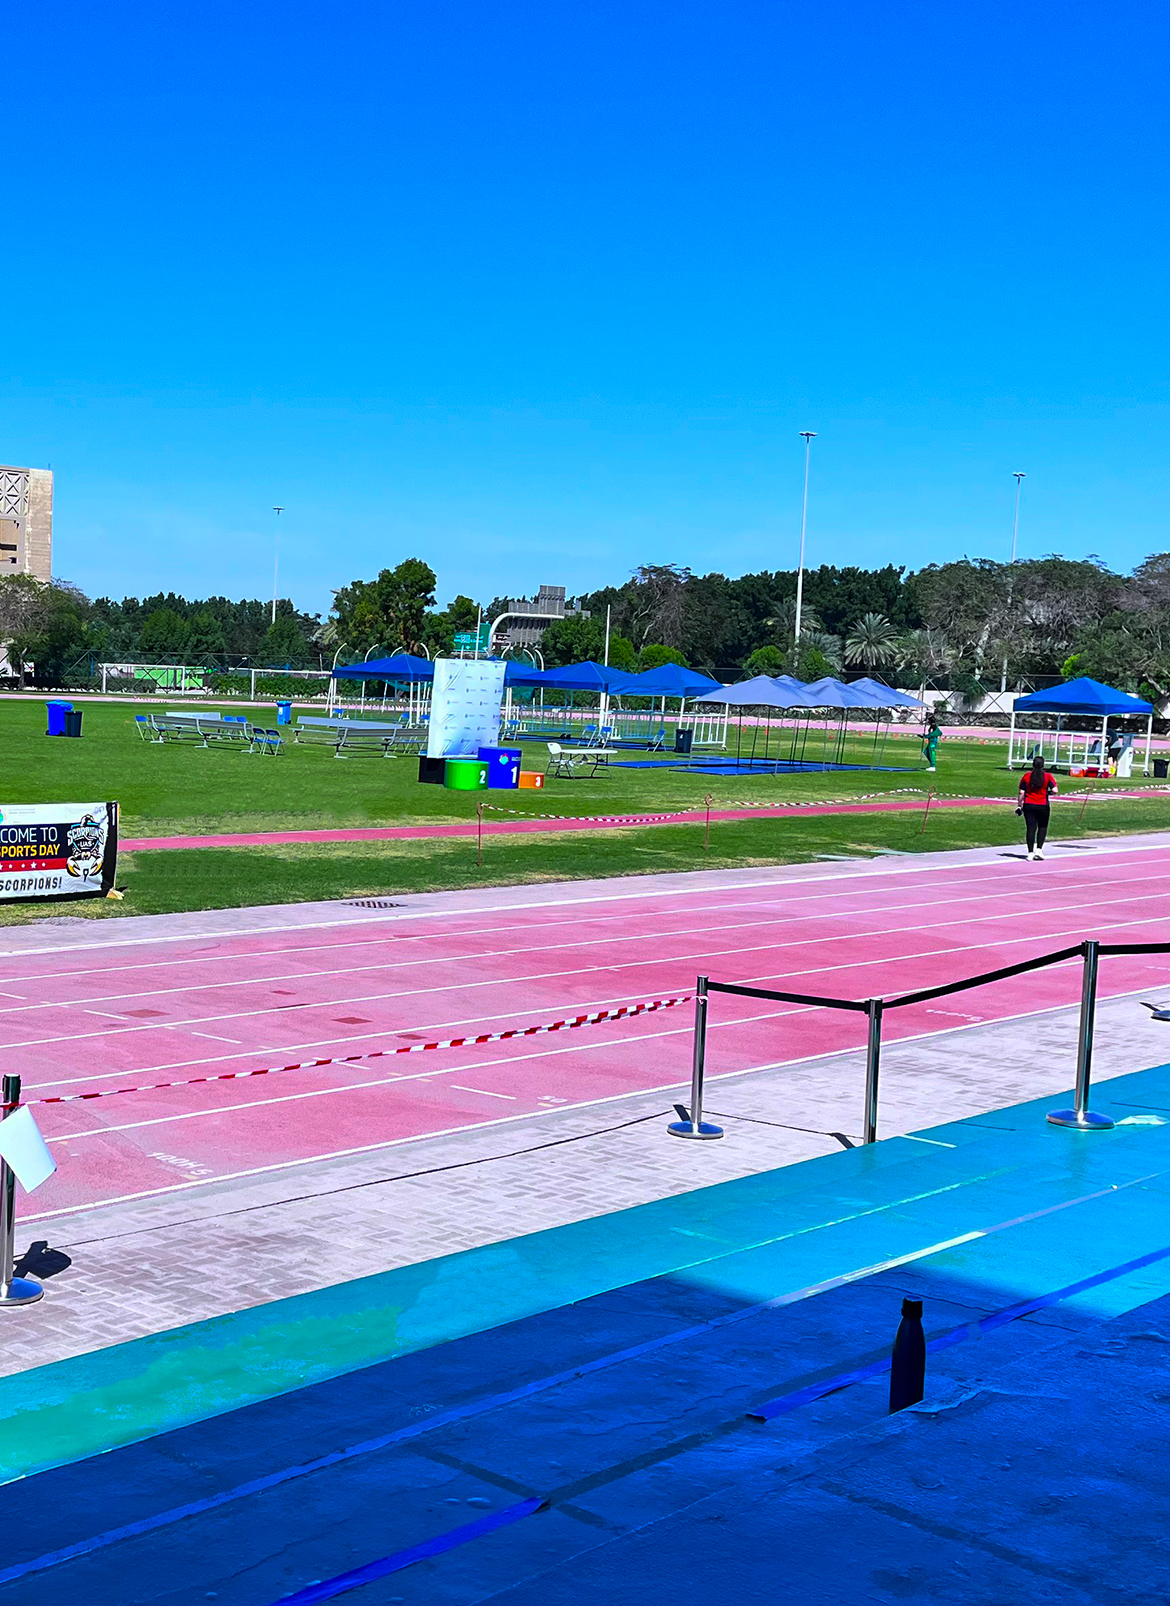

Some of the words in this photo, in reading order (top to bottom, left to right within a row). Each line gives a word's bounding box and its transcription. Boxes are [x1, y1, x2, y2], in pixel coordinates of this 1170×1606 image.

[479, 770, 486, 784] 2
[511, 766, 518, 784] 1
[39, 826, 58, 842] TO
[40, 843, 60, 856] DAY
